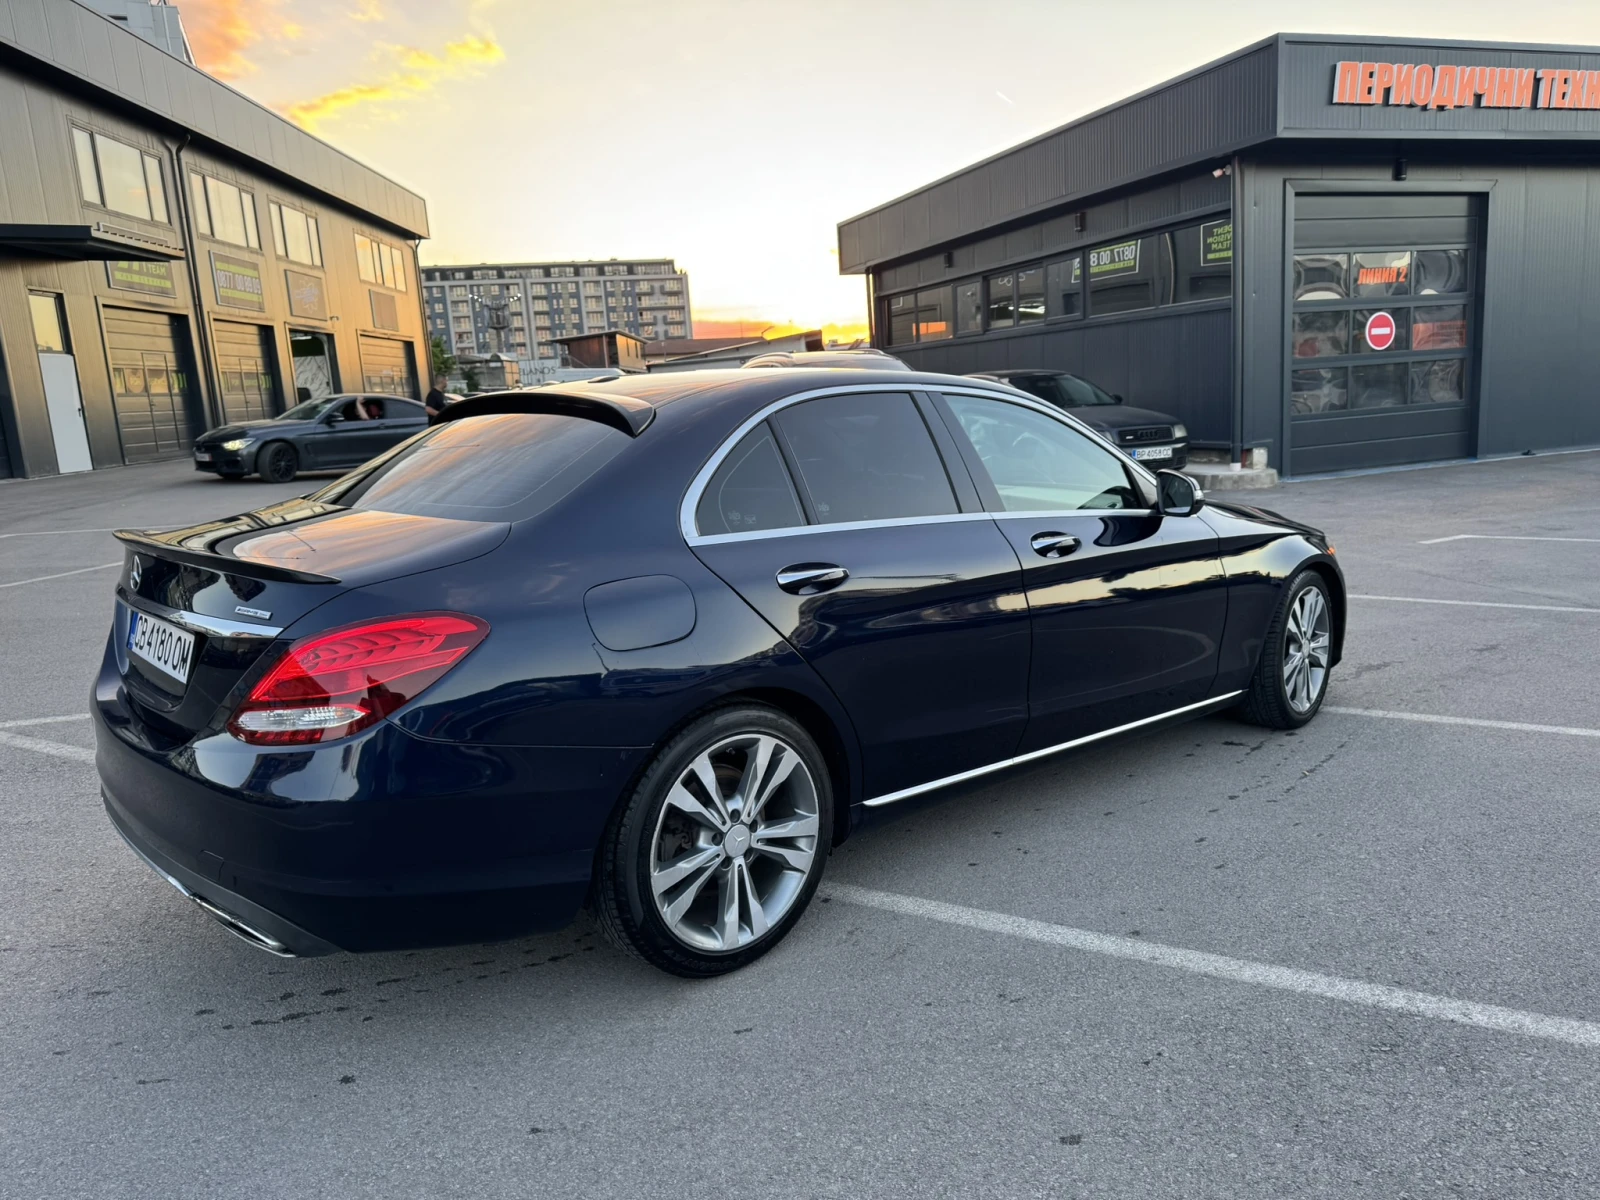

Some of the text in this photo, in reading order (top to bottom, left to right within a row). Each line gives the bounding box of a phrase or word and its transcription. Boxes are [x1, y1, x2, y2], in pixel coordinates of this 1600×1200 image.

[1333, 61, 1535, 110] ПЕРИОДИЧНИ
[148, 263, 166, 276] TEAM
[1399, 267, 1407, 282] 2
[217, 270, 233, 289] 0877
[235, 274, 245, 291] 00
[135, 615, 191, 676] CB 4180 OM
